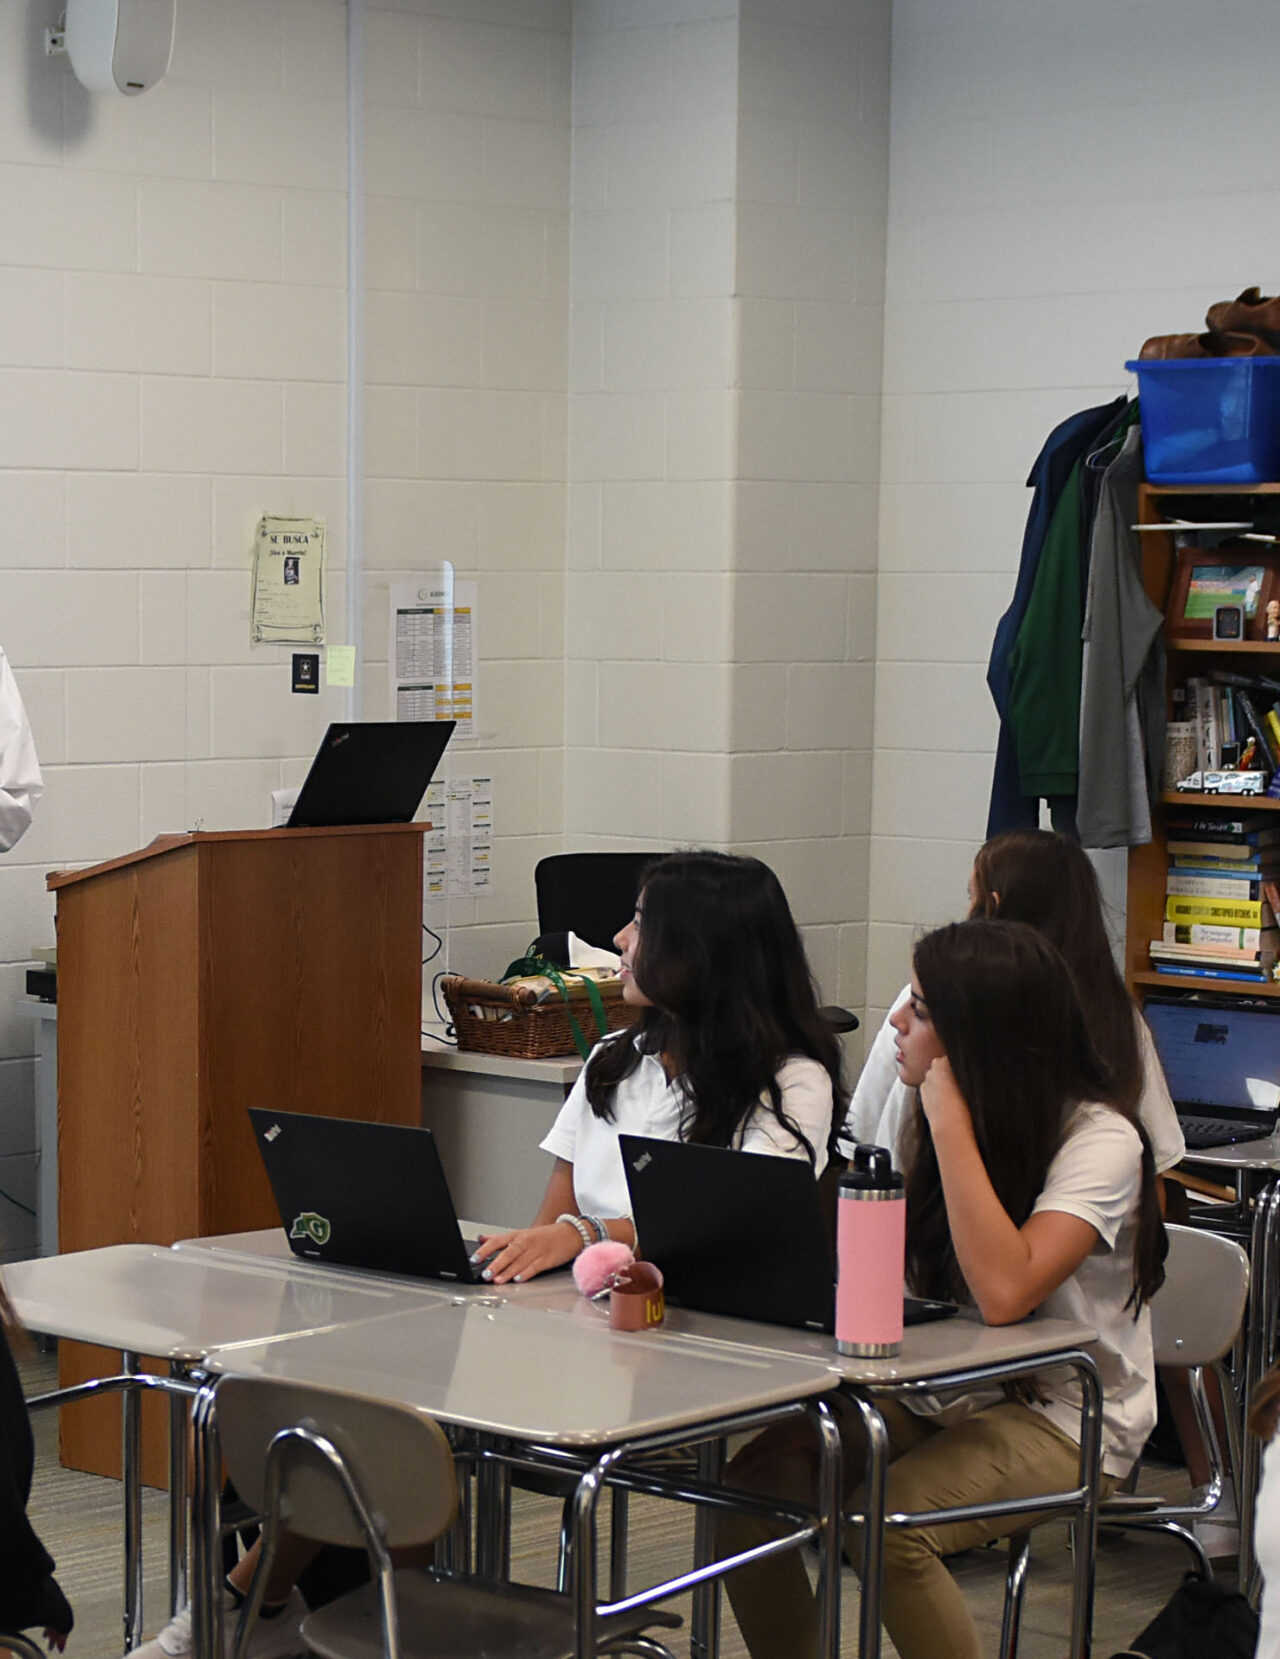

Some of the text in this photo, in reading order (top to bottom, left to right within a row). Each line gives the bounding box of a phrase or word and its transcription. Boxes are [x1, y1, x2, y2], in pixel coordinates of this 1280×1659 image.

[270, 535, 309, 544] SE BUSCA
[309, 1220, 322, 1237] G
